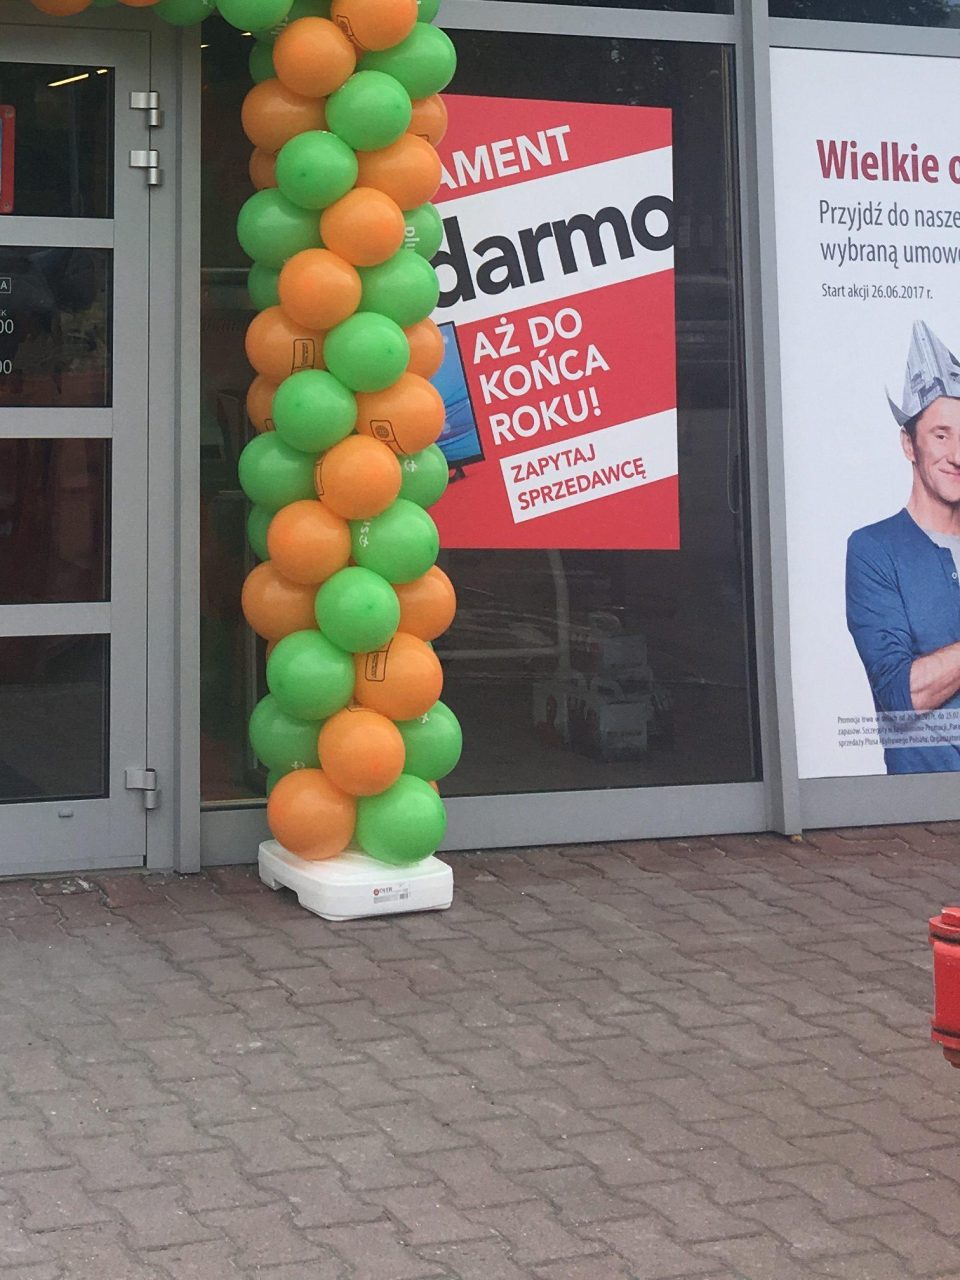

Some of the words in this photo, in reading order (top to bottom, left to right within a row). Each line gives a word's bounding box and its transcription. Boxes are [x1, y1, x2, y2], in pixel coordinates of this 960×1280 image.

[816, 139, 940, 184] Wielkie
[819, 199, 883, 232] Przyjdź
[888, 202, 909, 227] do
[431, 195, 674, 308] darmo
[820, 236, 900, 270] wybraną
[903, 244, 960, 265] umow
[821, 282, 846, 298] Start
[847, 284, 870, 302] akcji
[871, 284, 924, 300] 26.06.2017
[926, 288, 934, 300] r.
[473, 316, 520, 365] AŻ
[528, 307, 582, 348] DO
[479, 344, 610, 405] KOŃCA
[489, 387, 602, 446] ROKU!
[510, 443, 596, 484] ZAPYTAJ
[517, 456, 647, 511] SPRZEDAWCĘ
